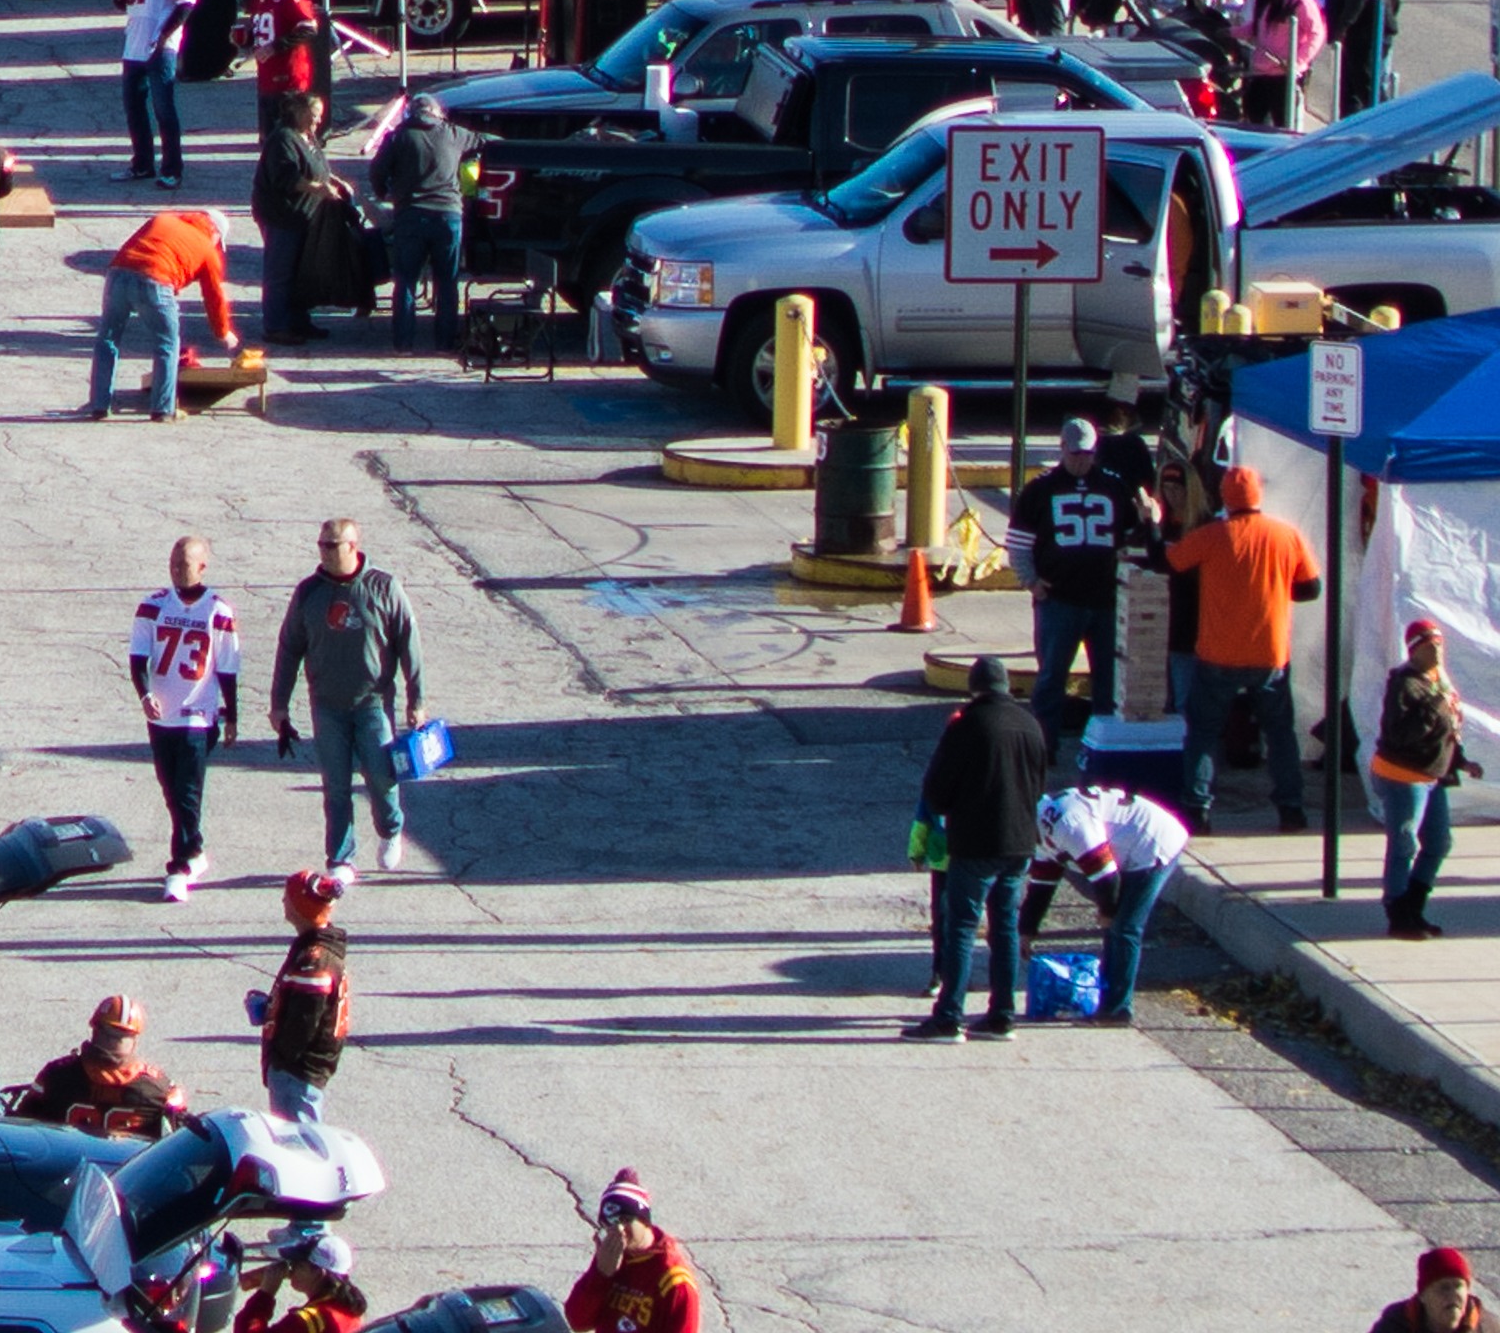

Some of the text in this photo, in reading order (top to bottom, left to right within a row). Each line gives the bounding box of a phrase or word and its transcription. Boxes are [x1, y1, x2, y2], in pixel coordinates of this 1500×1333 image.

[980, 142, 1075, 182] EXIT
[969, 190, 1083, 231] ONLY
[1314, 370, 1355, 387] PARKING
[1325, 353, 1345, 370] NO
[1325, 387, 1344, 399] ANY
[1051, 493, 1115, 547] 52
[156, 625, 211, 681] 73
